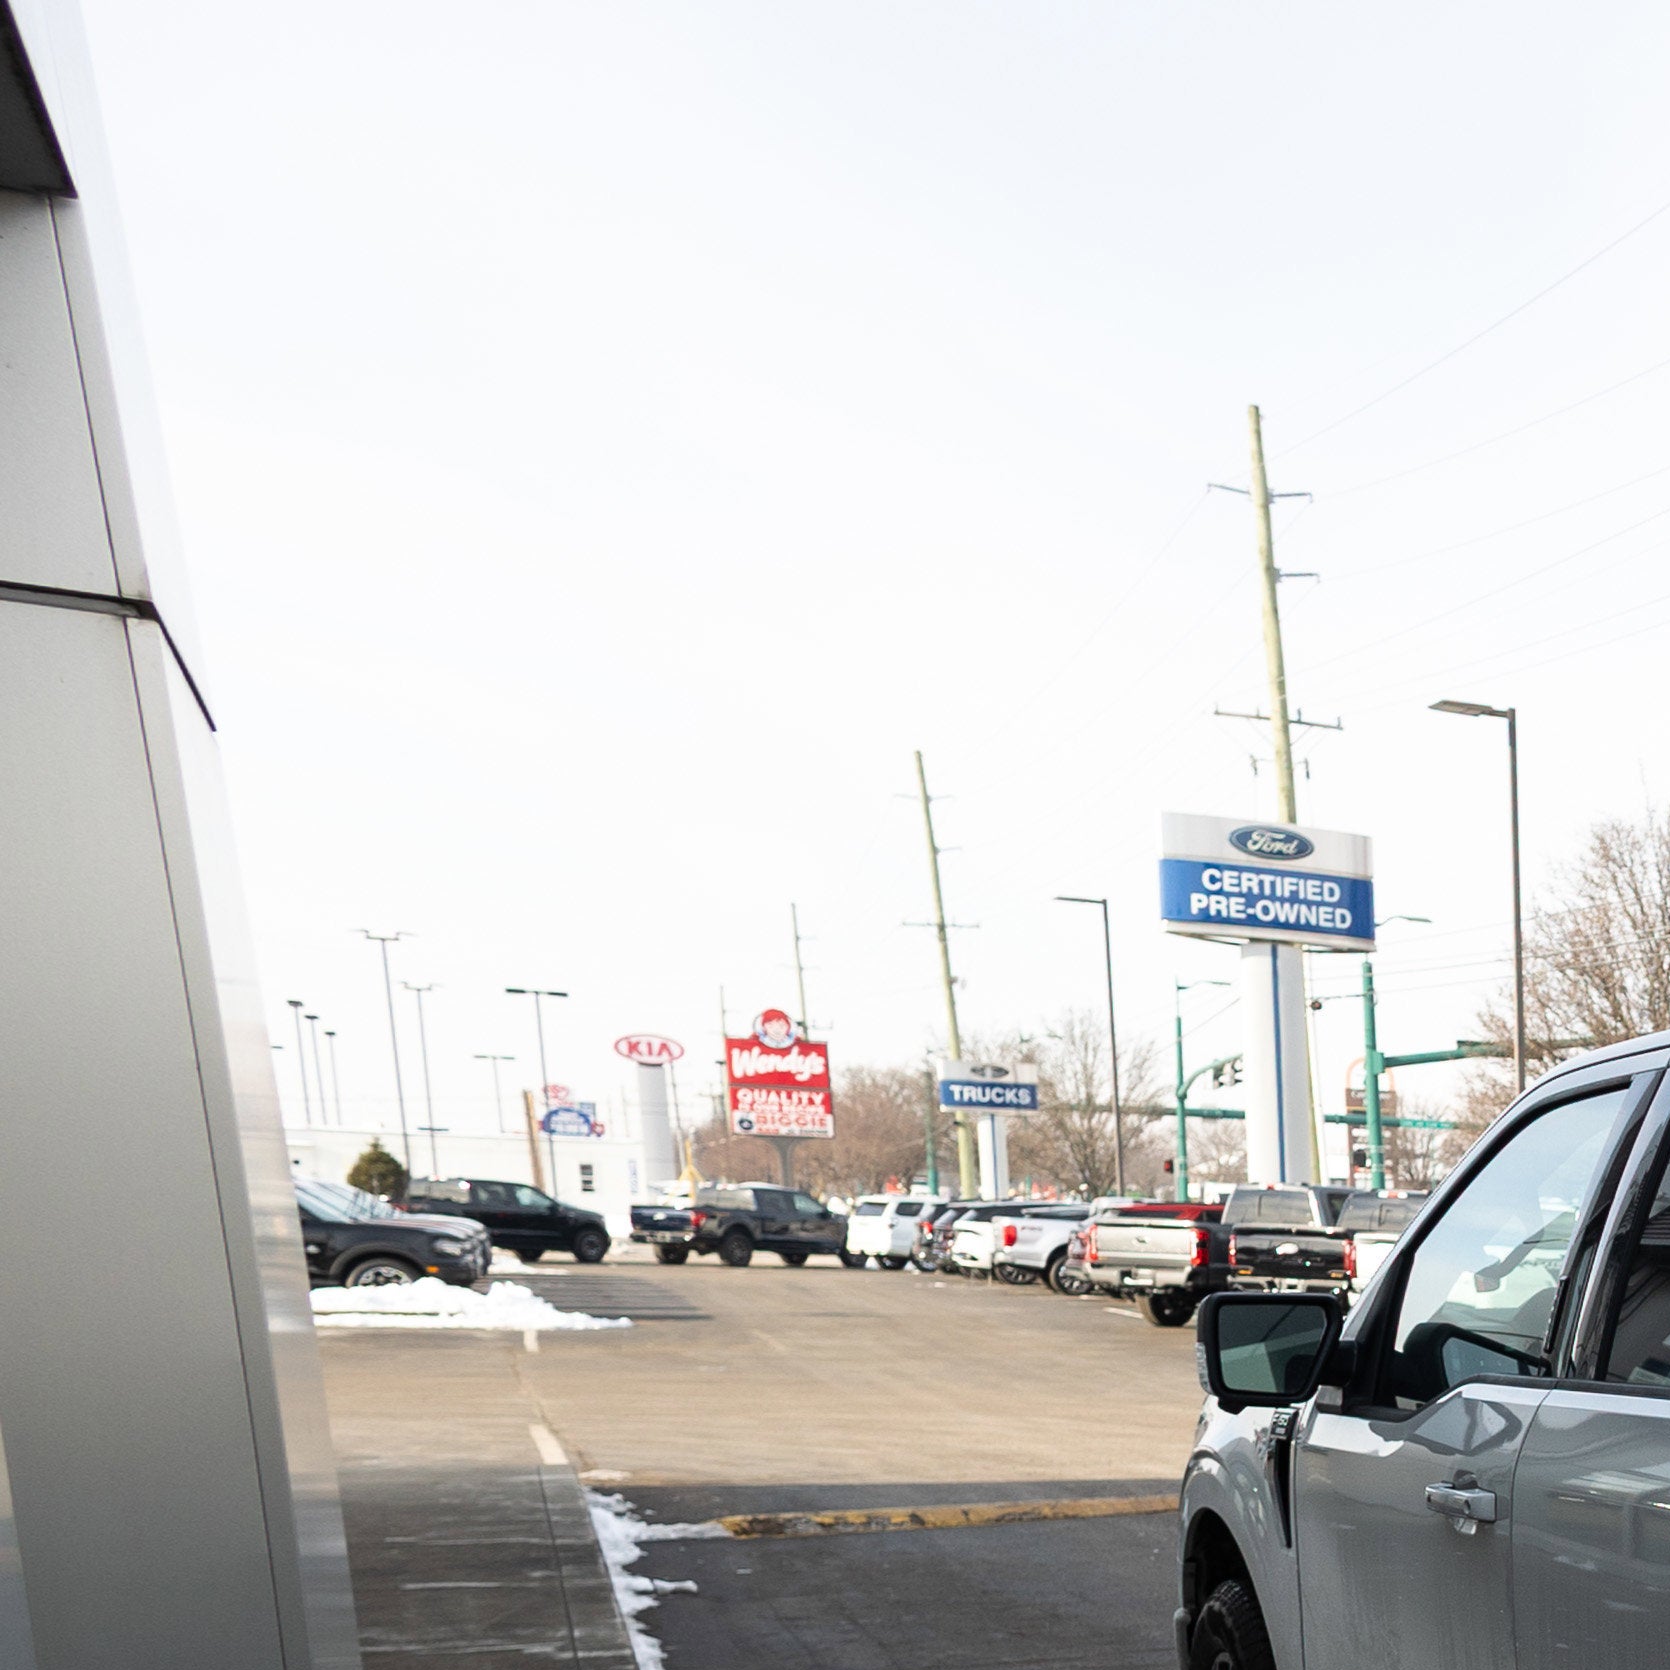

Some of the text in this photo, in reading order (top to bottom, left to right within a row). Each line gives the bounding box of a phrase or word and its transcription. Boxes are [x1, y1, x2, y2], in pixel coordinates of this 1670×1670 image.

[1246, 829, 1299, 856] Ford
[1201, 867, 1341, 903] CERTIFIED
[1189, 892, 1353, 930] PRE-OWNED
[626, 1040, 674, 1057] KIA
[730, 1045, 826, 1082] Wendy's
[736, 1087, 825, 1105] QUALITY
[948, 1084, 1032, 1106] TRUCKS
